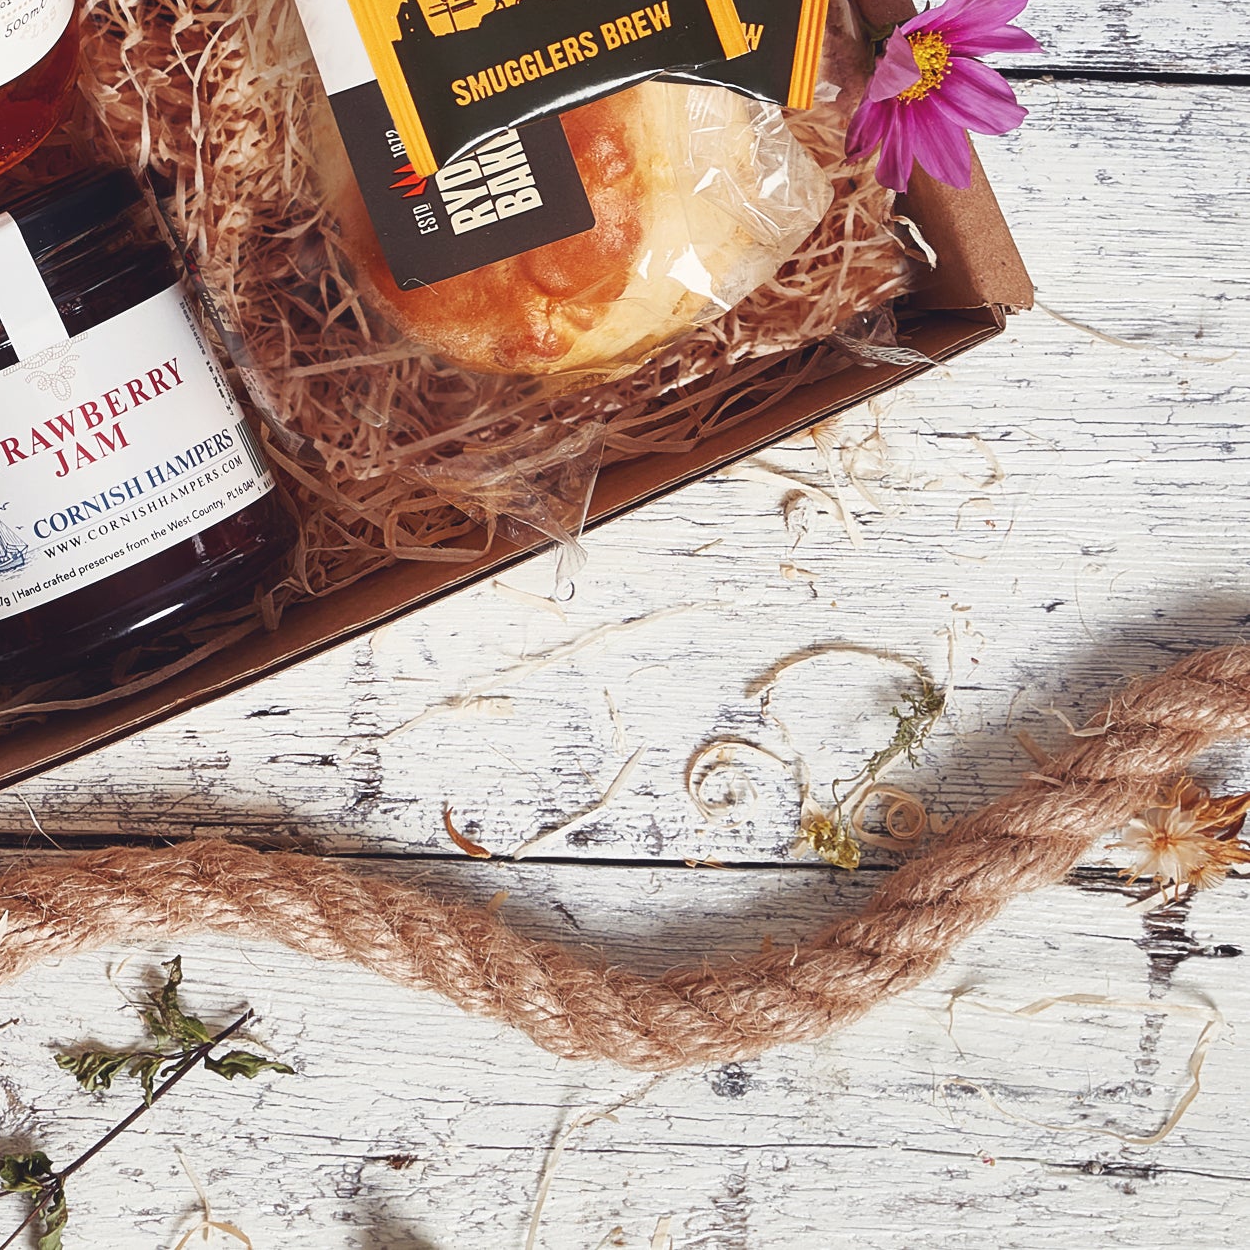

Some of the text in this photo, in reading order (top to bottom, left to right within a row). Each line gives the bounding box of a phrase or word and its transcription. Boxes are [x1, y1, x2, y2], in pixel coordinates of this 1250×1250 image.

[451, 31, 599, 106] SMUGGLERS
[601, 0, 672, 51] BREW
[413, 202, 439, 235] ESTD
[435, 152, 499, 235] RYD
[33, 428, 235, 540] CORNISH HAMPERS
[54, 421, 131, 478] JAM
[17, 583, 42, 600] Hand
[43, 568, 77, 590] crafted
[79, 548, 125, 577] preserves
[126, 536, 150, 552] from
[151, 526, 168, 541] the
[167, 516, 192, 533] West
[192, 499, 226, 521] Country,
[226, 486, 244, 500] PL16
[43, 455, 244, 559] WWW.CORNISHHAMPERS.COM
